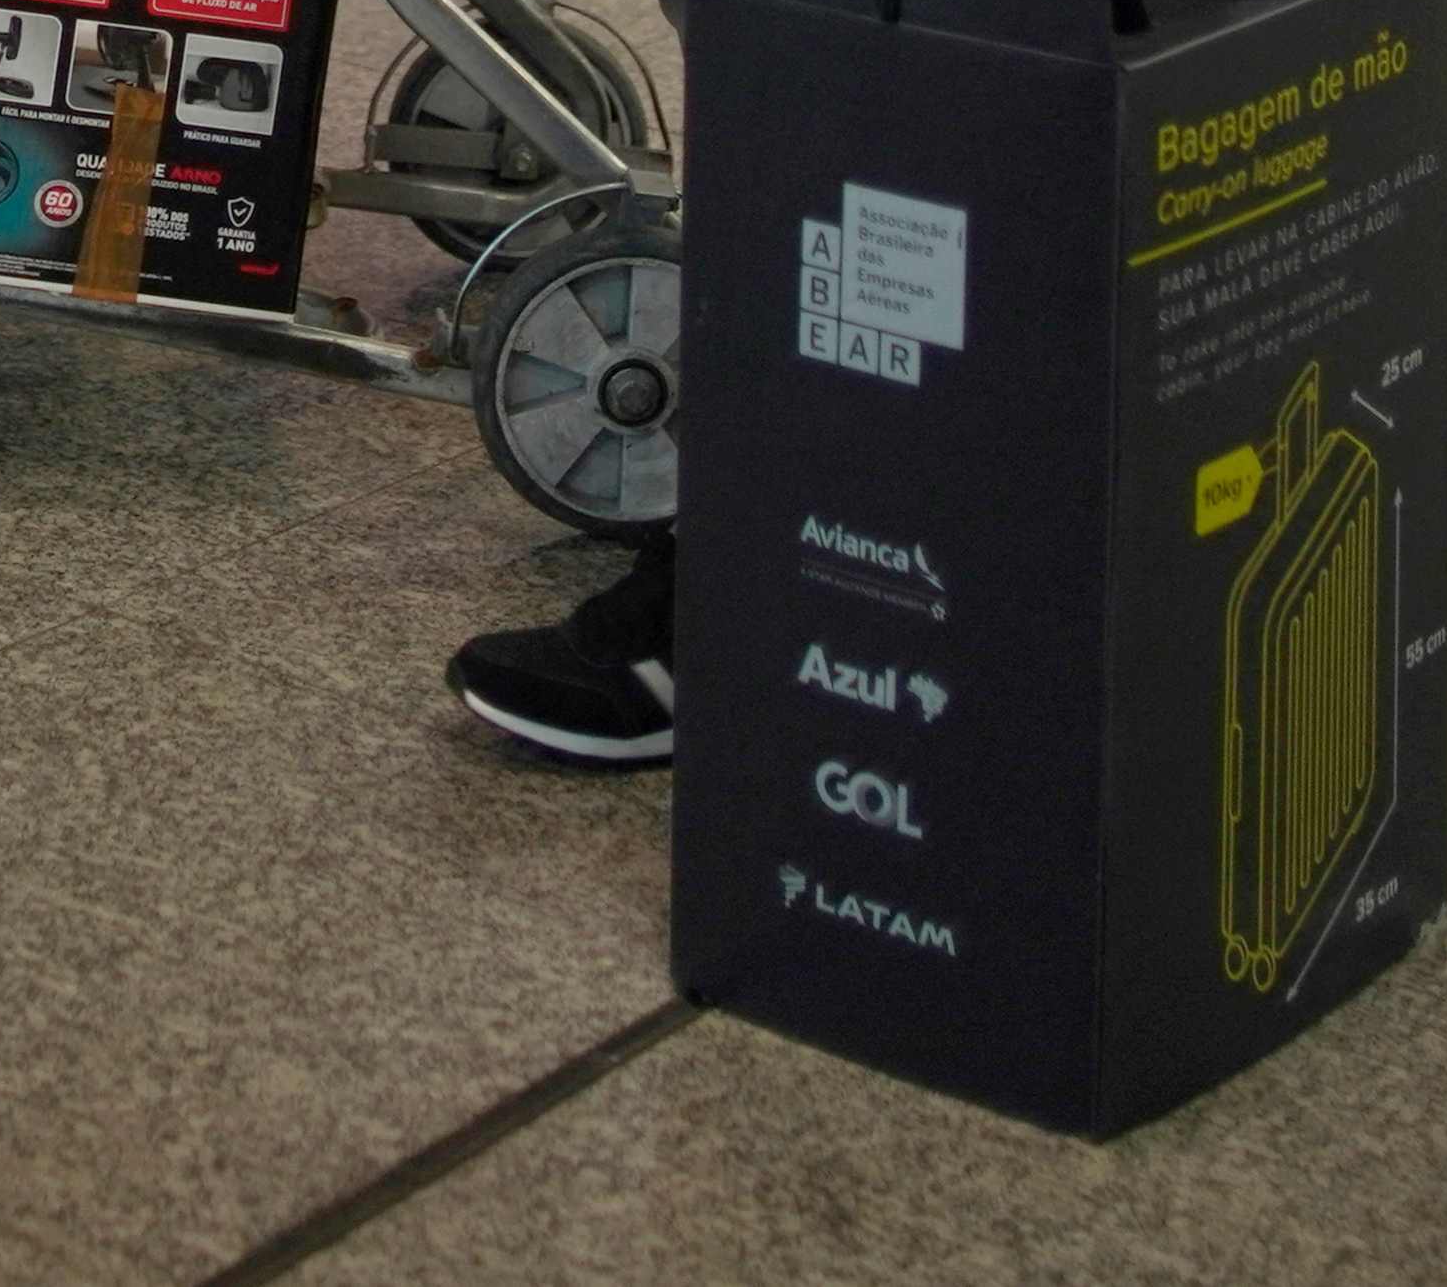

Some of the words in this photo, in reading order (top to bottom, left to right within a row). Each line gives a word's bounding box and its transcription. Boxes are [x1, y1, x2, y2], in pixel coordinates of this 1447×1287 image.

[228, 1, 242, 11] DE
[244, 2, 258, 13] AR
[1158, 85, 1302, 173] Bagagem
[1310, 62, 1346, 110] de
[1353, 28, 1408, 93] mão
[44, 190, 74, 208] 60
[1157, 168, 1248, 226] Carry-on
[1253, 133, 1330, 188] luggage
[858, 205, 949, 241] Associação
[858, 226, 935, 258] Brasileira
[1158, 262, 1207, 298] PARA
[1214, 233, 1271, 278] LEVAR
[1276, 222, 1299, 246] NA
[1305, 190, 1363, 236] CABINE
[1367, 177, 1390, 205] DO
[217, 237, 224, 250] 1
[224, 238, 255, 254] ANO
[857, 247, 886, 267] das
[857, 267, 935, 301] Empresas
[1158, 297, 1197, 332] SUA
[1204, 274, 1253, 309] MALA
[1259, 250, 1303, 289] DEVE
[1309, 223, 1359, 264] CABER
[857, 289, 912, 315] Aéreas
[1380, 354, 1401, 388] 25
[1402, 347, 1424, 375] cm
[1202, 473, 1245, 512] 10kg
[800, 513, 910, 574] Avianca
[1405, 638, 1426, 671] 55
[797, 643, 897, 712] Azul
[814, 759, 924, 840] GOL
[1354, 891, 1375, 923] 35
[1375, 875, 1401, 907] cm
[814, 883, 957, 957] LATAM
